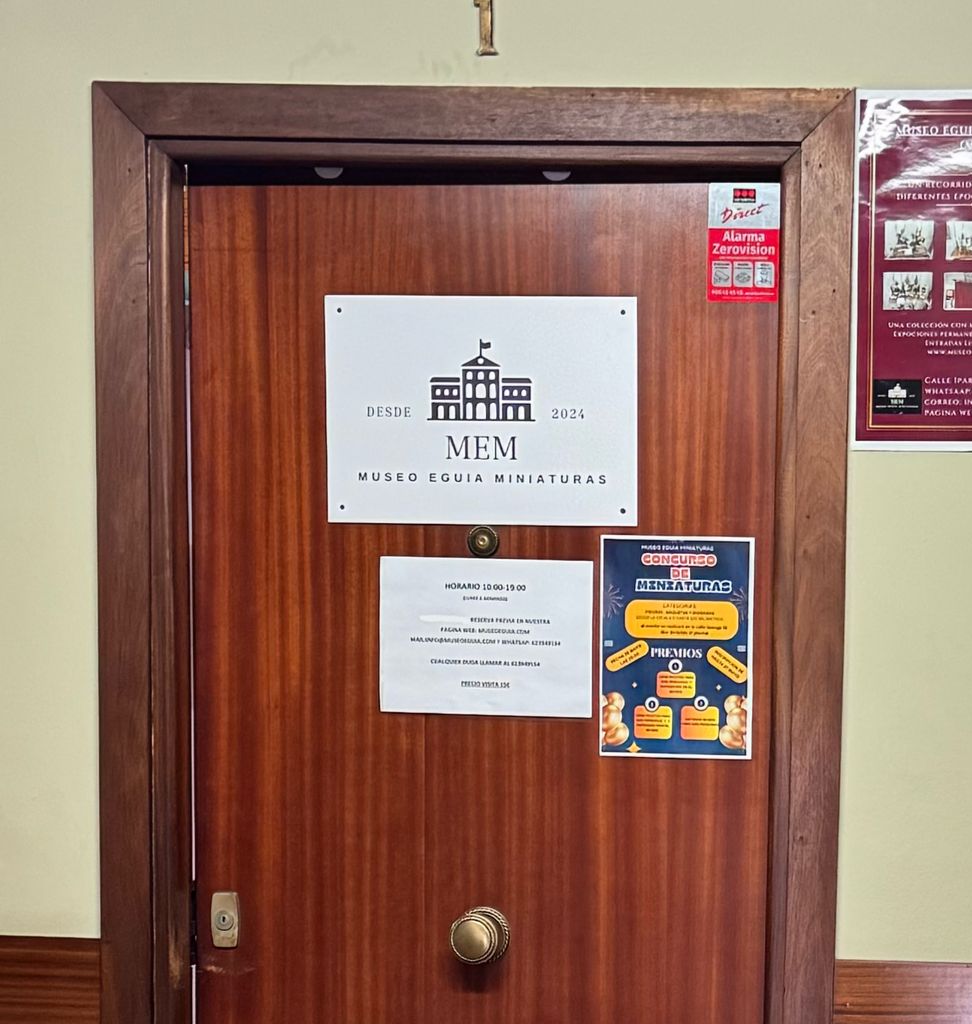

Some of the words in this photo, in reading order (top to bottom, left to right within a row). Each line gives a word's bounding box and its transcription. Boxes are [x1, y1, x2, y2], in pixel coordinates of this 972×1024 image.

[723, 230, 765, 242] Alarma
[712, 243, 775, 255] Zerovision
[367, 406, 412, 418] DESDE
[551, 408, 585, 420] 2024
[446, 435, 518, 460] MEM
[358, 472, 418, 482] MUSEO
[429, 473, 483, 483] EGUIA
[495, 474, 607, 485] MINIATURAS
[641, 553, 717, 567] CONCURSO
[670, 567, 690, 580] DE
[635, 579, 732, 593] MINIATURAS
[651, 647, 703, 659] PREMIOS
